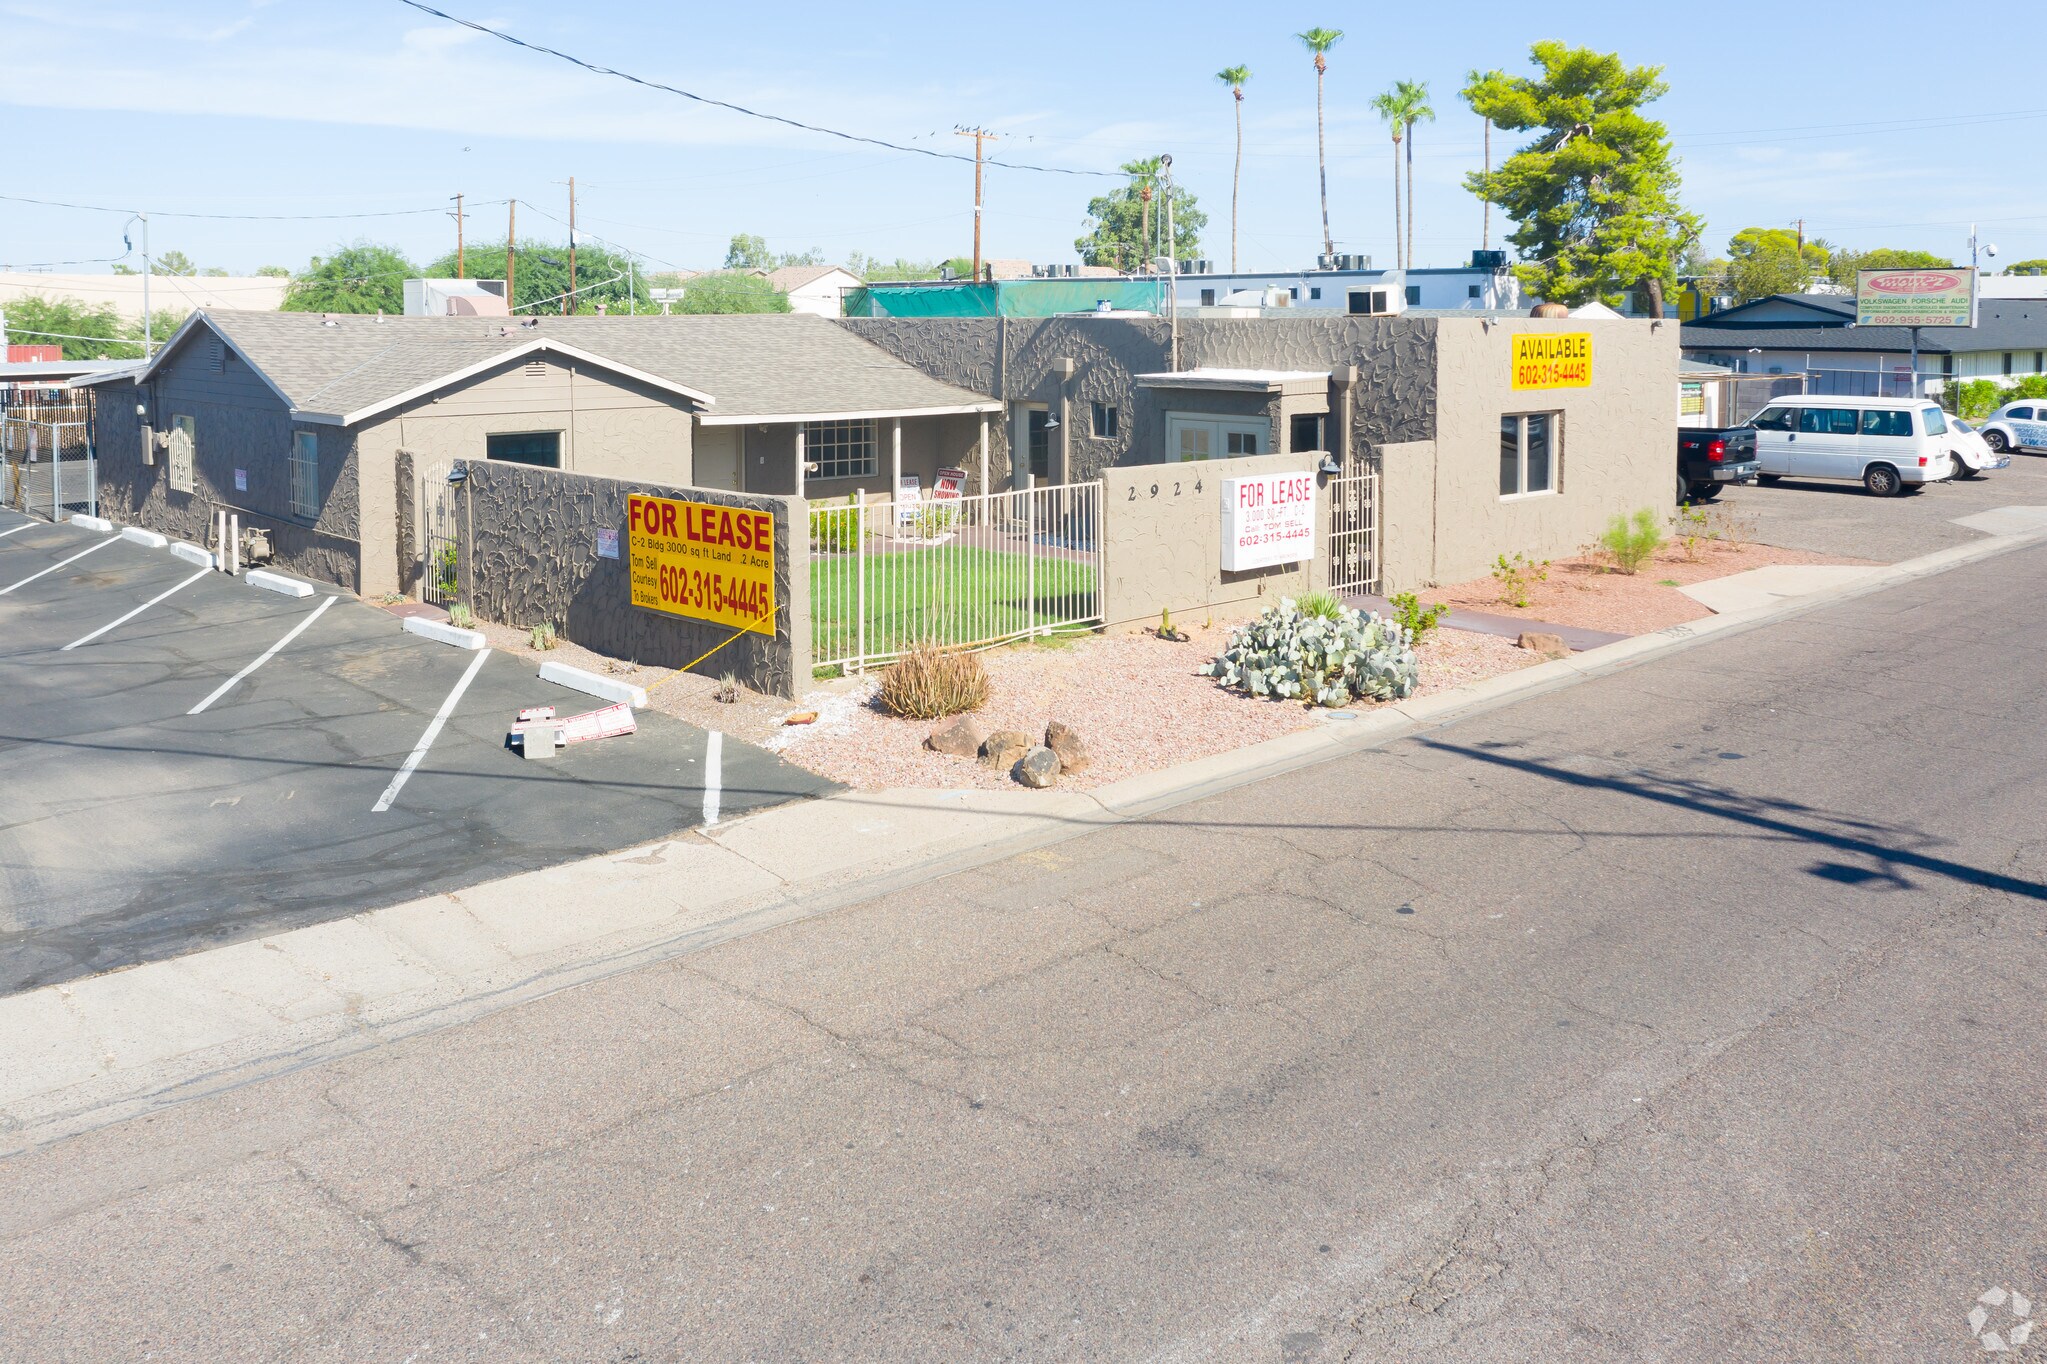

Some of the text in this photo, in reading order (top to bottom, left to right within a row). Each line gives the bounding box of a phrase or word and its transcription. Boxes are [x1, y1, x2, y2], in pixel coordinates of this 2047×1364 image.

[1520, 338, 1586, 360] AVAILABLE
[1519, 363, 1586, 385] 602-315-4445
[940, 478, 958, 490] NOW
[1240, 478, 1311, 508] FOR LEASE
[630, 498, 770, 553] FOR LEASE
[1284, 519, 1303, 528] SELL
[632, 536, 645, 548] C-2
[648, 539, 665, 552] Bldg
[667, 541, 687, 555] 3000
[691, 547, 700, 557] sq
[702, 547, 709, 558] ft
[712, 548, 731, 562] Land
[750, 555, 769, 569] Acre
[632, 553, 657, 571] Tom Sell
[632, 570, 658, 589] Courtesy
[634, 589, 659, 606] To Brokers
[659, 564, 769, 623] 602-315-4445
